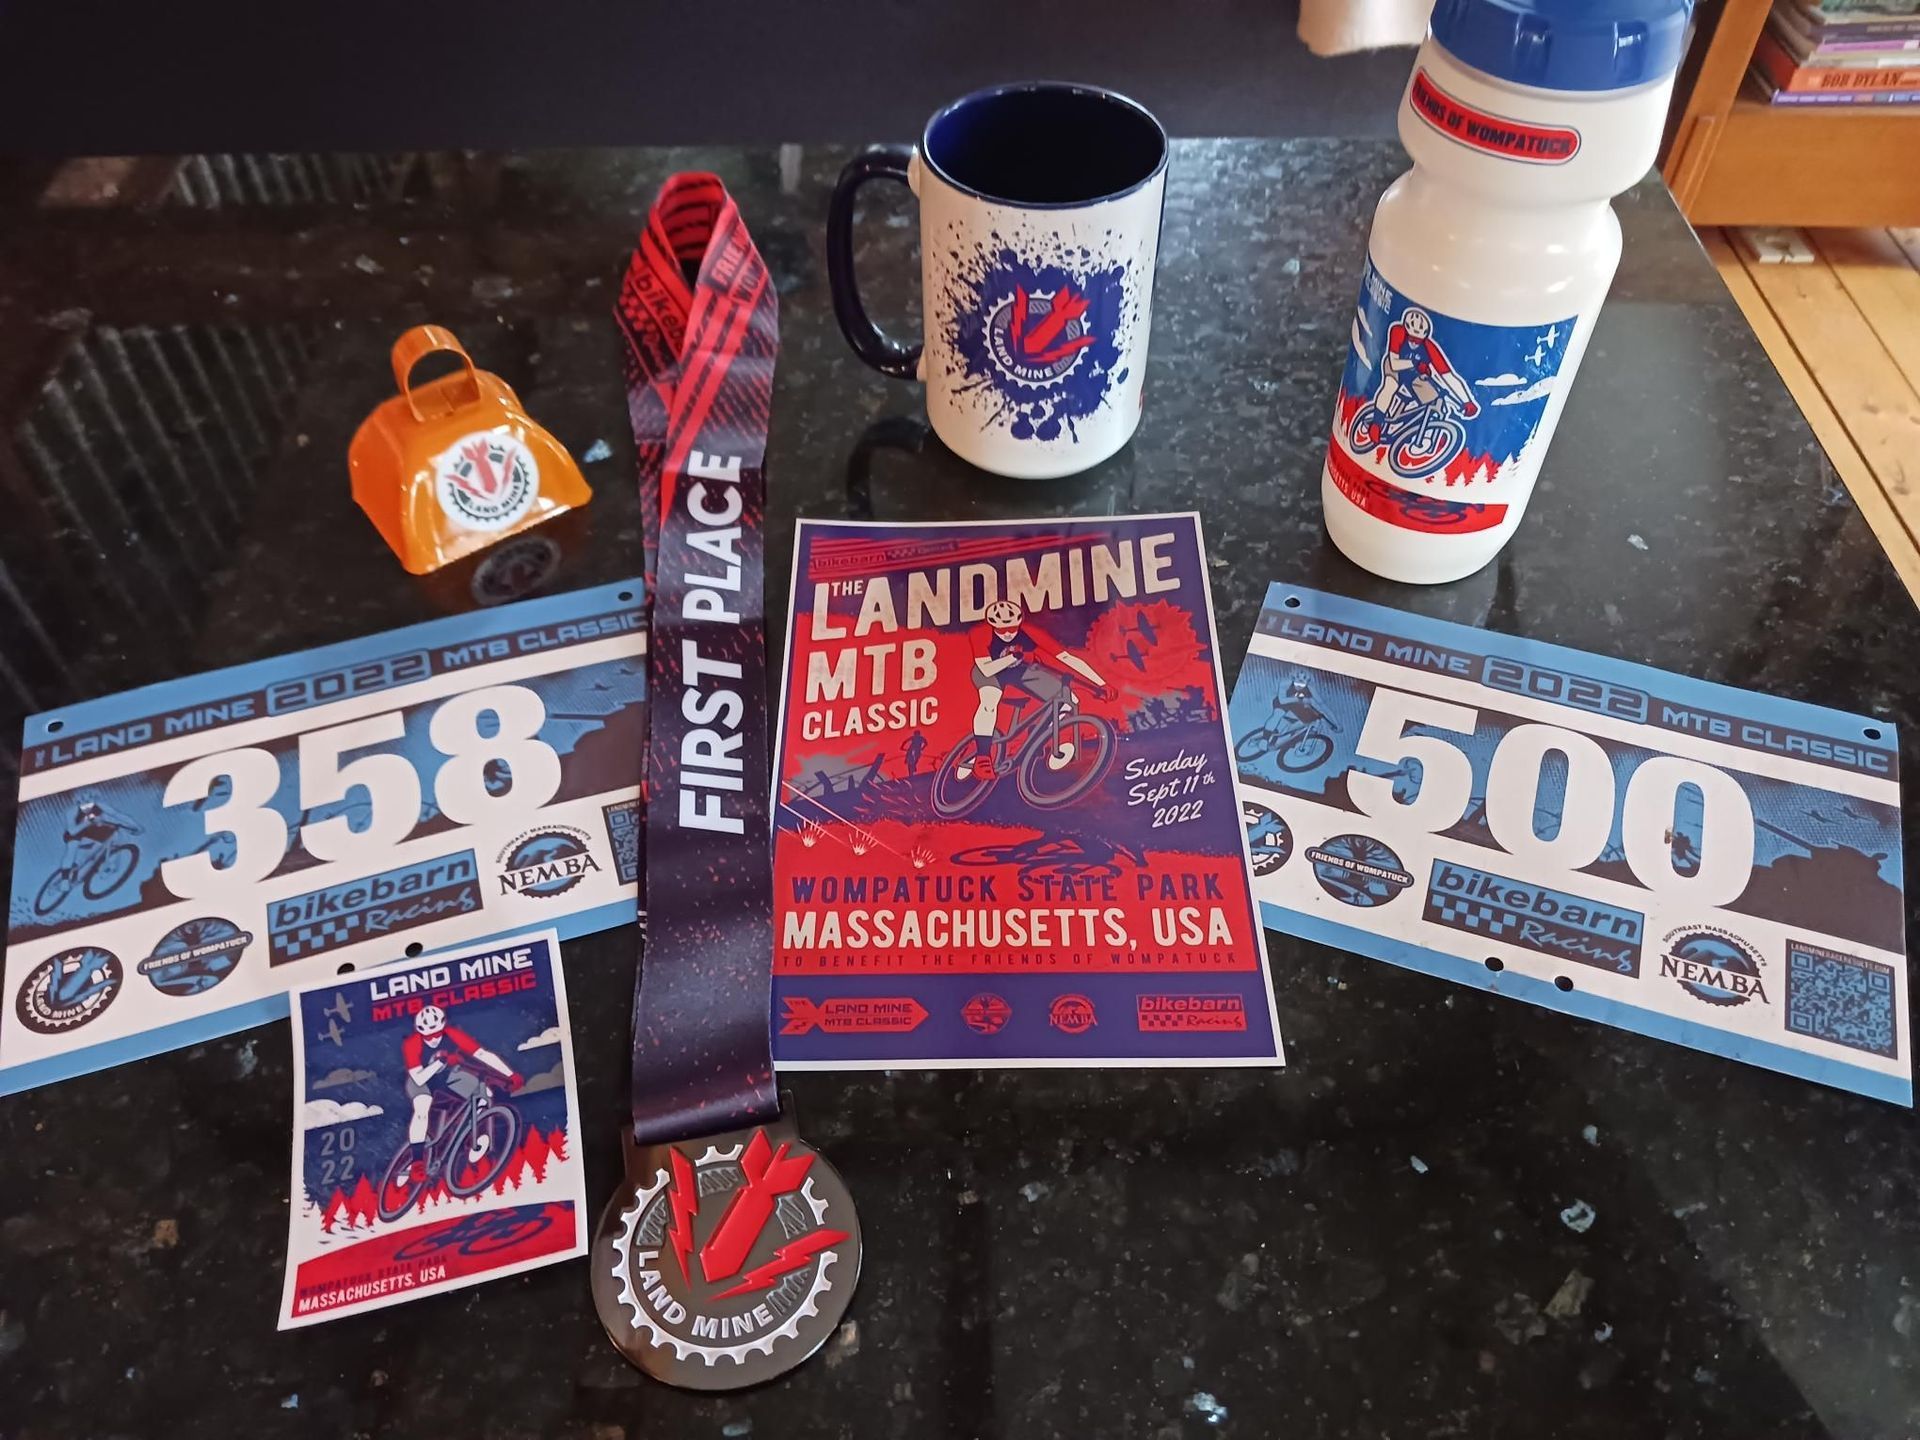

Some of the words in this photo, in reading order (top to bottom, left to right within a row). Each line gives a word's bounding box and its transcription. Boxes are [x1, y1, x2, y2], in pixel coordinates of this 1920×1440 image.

[1821, 73, 1849, 88] BOB
[1853, 71, 1904, 87] DYLAN
[1447, 112, 1463, 130] OF
[1466, 119, 1571, 154] WOMPATUCK
[994, 328, 1013, 366] LAND
[1014, 364, 1054, 379] MINE
[681, 450, 743, 624] PLACE
[810, 532, 1181, 642] LANDMINE
[831, 580, 864, 597] THE
[52, 722, 152, 763] LAND
[165, 698, 255, 735] MINE
[273, 654, 427, 708] 2022
[443, 637, 510, 669] MTB
[518, 611, 647, 652] CLASSIC
[806, 639, 938, 703] MTB
[1281, 619, 1374, 652] LAND
[1384, 641, 1472, 675] MINE
[1489, 660, 1643, 717] 2022
[1662, 706, 1732, 738] MTB
[1741, 725, 1889, 773] CLASSIC
[678, 639, 745, 834] FIRST
[802, 697, 939, 742] CLASSIC
[1124, 749, 1208, 780] Sunday
[161, 684, 562, 900] 358
[1128, 778, 1180, 809] Sept
[1347, 686, 1755, 907] 500
[1151, 800, 1204, 828] 2022
[497, 854, 603, 895] NEMBA
[791, 873, 997, 905] WOMPATUCK
[1017, 871, 1116, 902] STATE
[1138, 871, 1224, 901] PARK
[1311, 851, 1344, 867] FRIENDS
[1345, 860, 1356, 869] OF
[1356, 864, 1408, 884] WOMPATUCK
[275, 858, 470, 928] bikebarn
[365, 888, 476, 934] Racing
[1437, 867, 1637, 938] bikebarn
[782, 907, 1138, 952] MASSACHUSETTS,
[1152, 906, 1233, 946] USA
[1519, 920, 1633, 972] Racing
[1662, 924, 1701, 943] SOUTHEAST
[1705, 924, 1767, 967] MASSACHUSETTS
[144, 955, 179, 970] FRIENDS
[181, 951, 192, 961] OF
[193, 936, 248, 957] WOMPATUCK
[783, 956, 802, 968] TO
[819, 955, 904, 967] BENEFIT
[922, 954, 954, 966] THE
[972, 953, 1056, 965] FRIENDS
[1073, 953, 1093, 965] OF
[1111, 952, 1237, 964] WOMPATUCK
[370, 966, 451, 1001] LAND
[460, 948, 534, 982] MINE
[1659, 954, 1771, 1005] NEMBA
[52, 1006, 83, 1018] MINE
[372, 997, 424, 1022] MTB
[433, 972, 537, 1008] CLASSIC
[825, 1004, 868, 1014] LAND
[873, 1003, 912, 1013] MINE
[1141, 997, 1240, 1011] bikebarn
[824, 1017, 851, 1026] MTB
[856, 1016, 912, 1026] CLASSIC
[1049, 1013, 1098, 1027] NEMBA
[1186, 1014, 1243, 1027] Racing
[320, 1128, 356, 1154] 20
[320, 1156, 355, 1183] 22
[420, 1265, 446, 1283] USA
[639, 1251, 686, 1325] LAND
[691, 1303, 774, 1339] MINE
